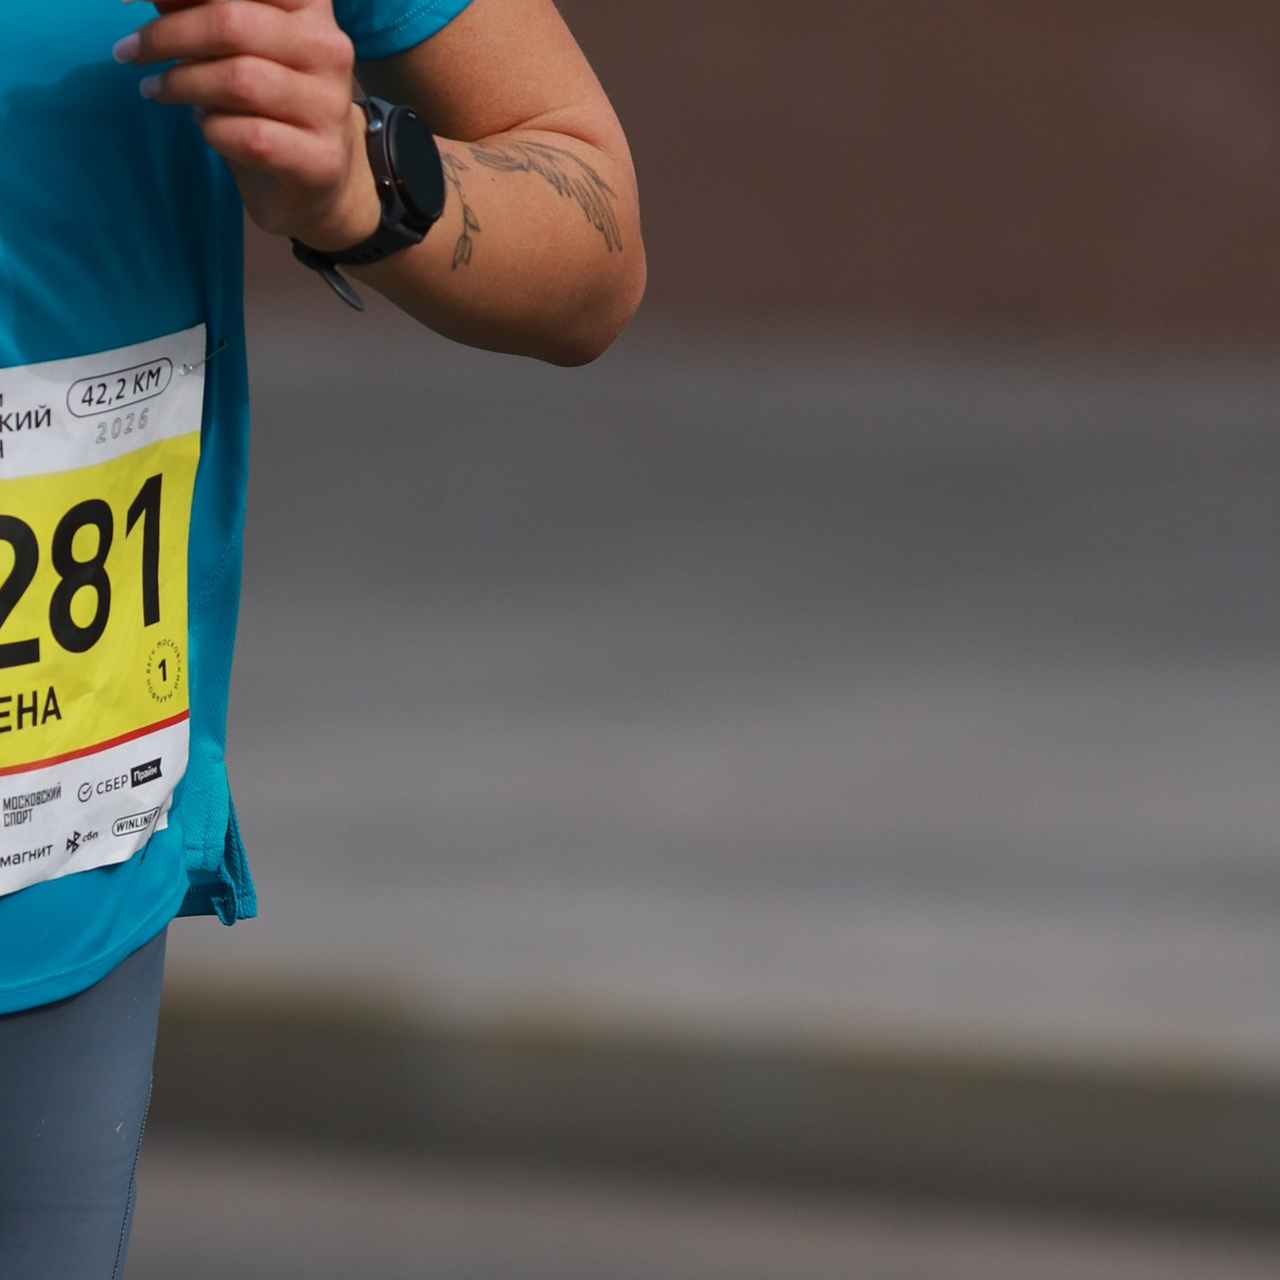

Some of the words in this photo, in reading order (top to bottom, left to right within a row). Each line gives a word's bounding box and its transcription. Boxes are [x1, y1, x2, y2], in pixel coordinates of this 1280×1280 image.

[81, 377, 126, 407] 42,2
[95, 407, 149, 444] 2026
[158, 658, 167, 682] 1
[96, 774, 129, 795] СБЕР
[133, 765, 158, 782] Прайм
[3, 782, 62, 812] МОСКОВСКИЙ
[3, 808, 33, 827] СПОРТ
